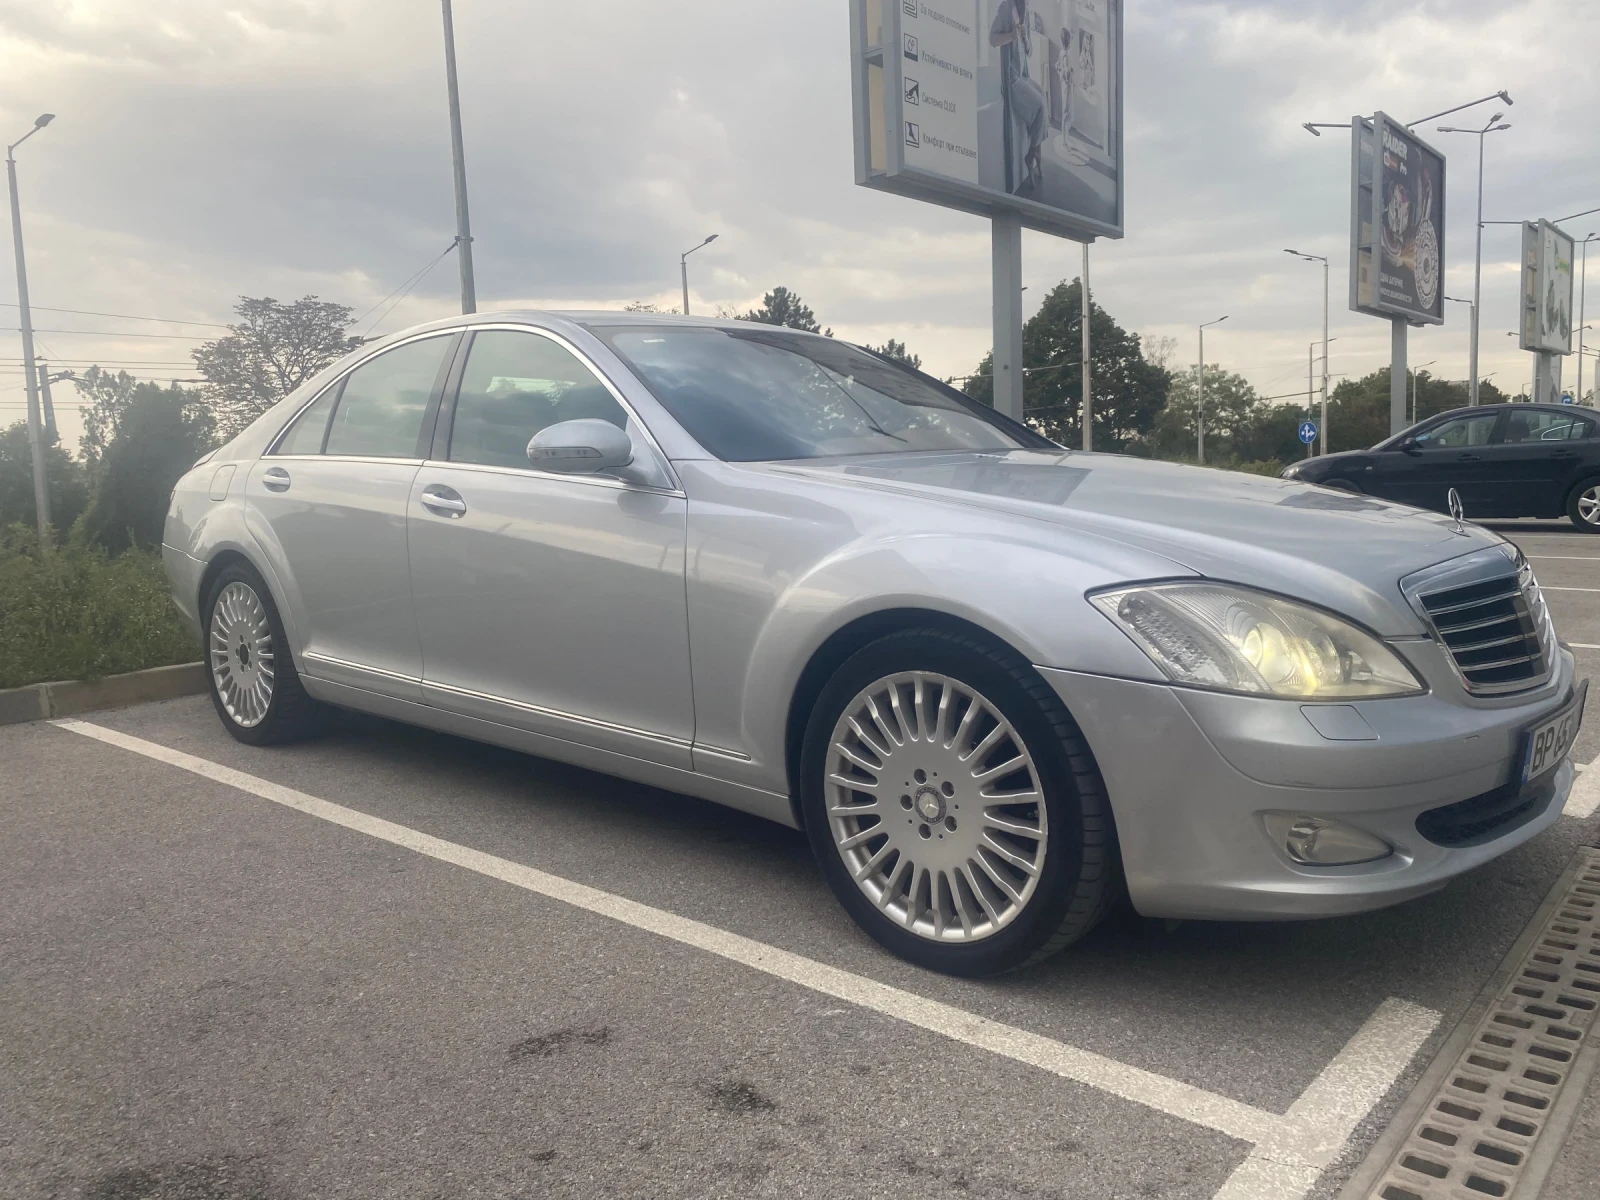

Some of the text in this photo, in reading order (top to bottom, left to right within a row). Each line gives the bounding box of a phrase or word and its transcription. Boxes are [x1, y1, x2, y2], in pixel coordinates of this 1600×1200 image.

[928, 8, 945, 24] подово
[945, 17, 970, 35] отопление
[921, 50, 973, 80] Устойчивост на влага
[922, 91, 957, 114] Система CLICK
[923, 132, 977, 159] Комфорт при стъпване
[1383, 130, 1407, 160] RAIDER
